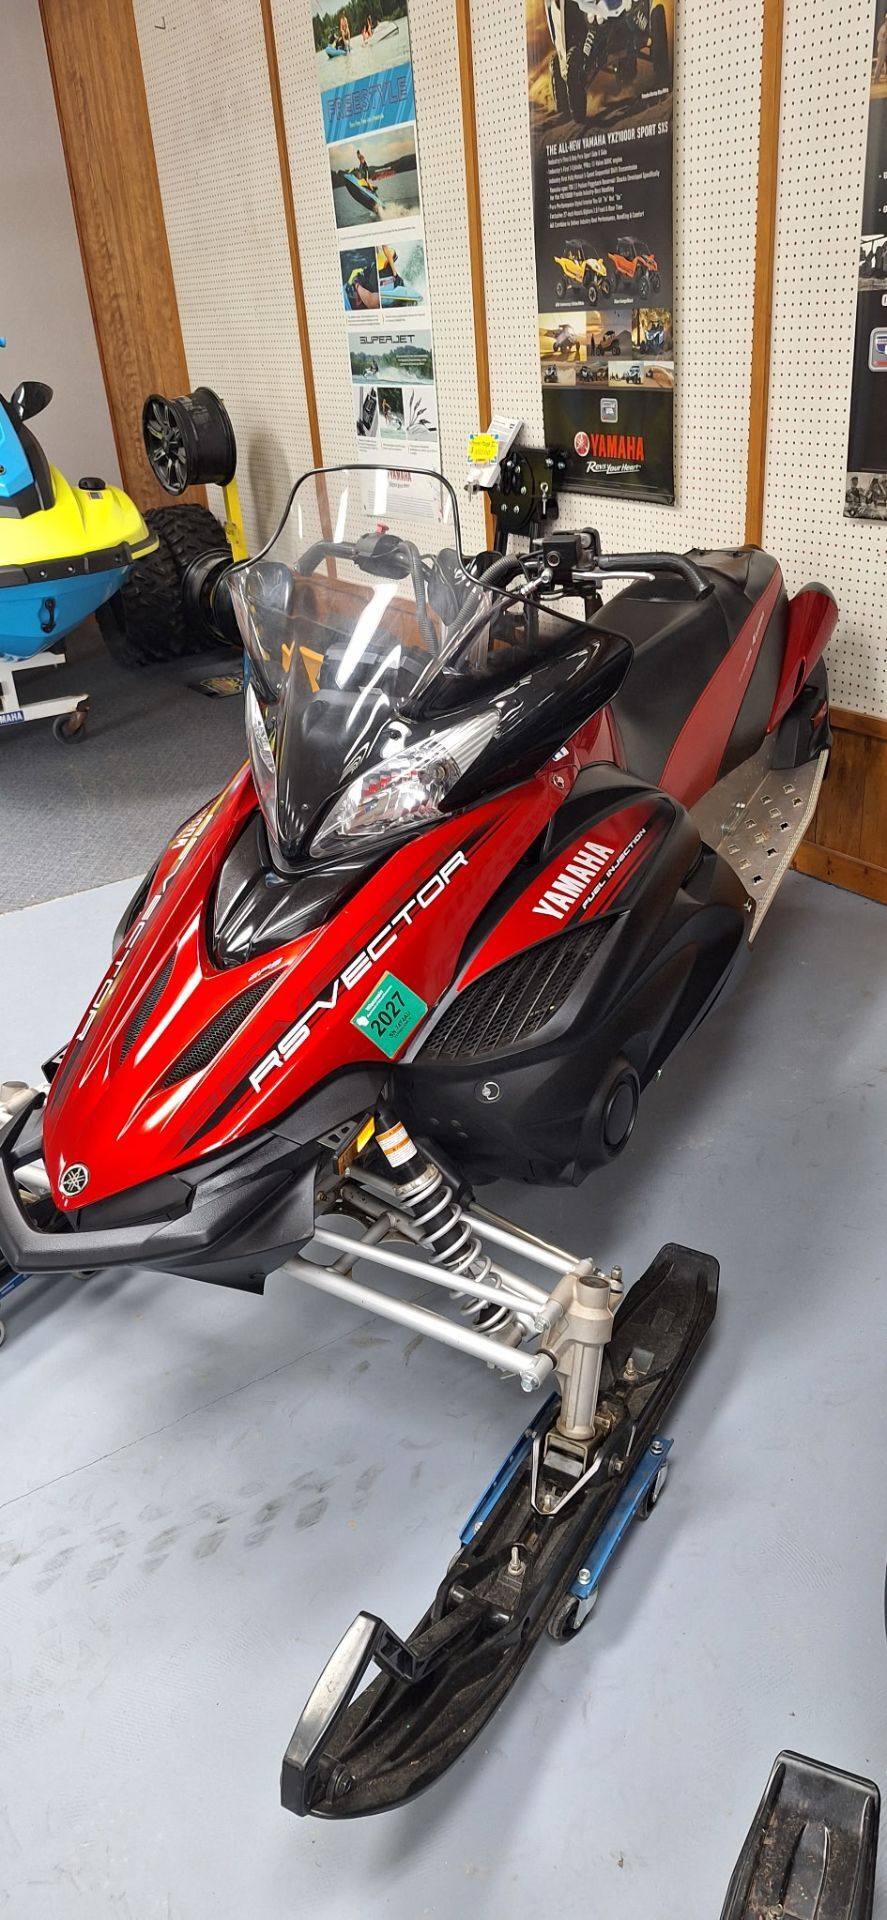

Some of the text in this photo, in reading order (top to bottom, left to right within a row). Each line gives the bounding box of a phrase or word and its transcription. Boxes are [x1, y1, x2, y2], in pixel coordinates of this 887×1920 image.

[327, 76, 408, 122] FREESTYLE
[546, 144, 558, 156] THE
[582, 136, 607, 149] YAMAHA
[636, 126, 656, 139] SPORT
[359, 334, 415, 345] SUPERJET
[586, 461, 640, 475] Revs Your Heart
[591, 432, 644, 461] YAMAHA
[532, 841, 615, 920] YAMAHA
[582, 827, 647, 911] FUEL INJECTION
[308, 850, 469, 1012] VECTOR
[370, 990, 406, 1038] 2027
